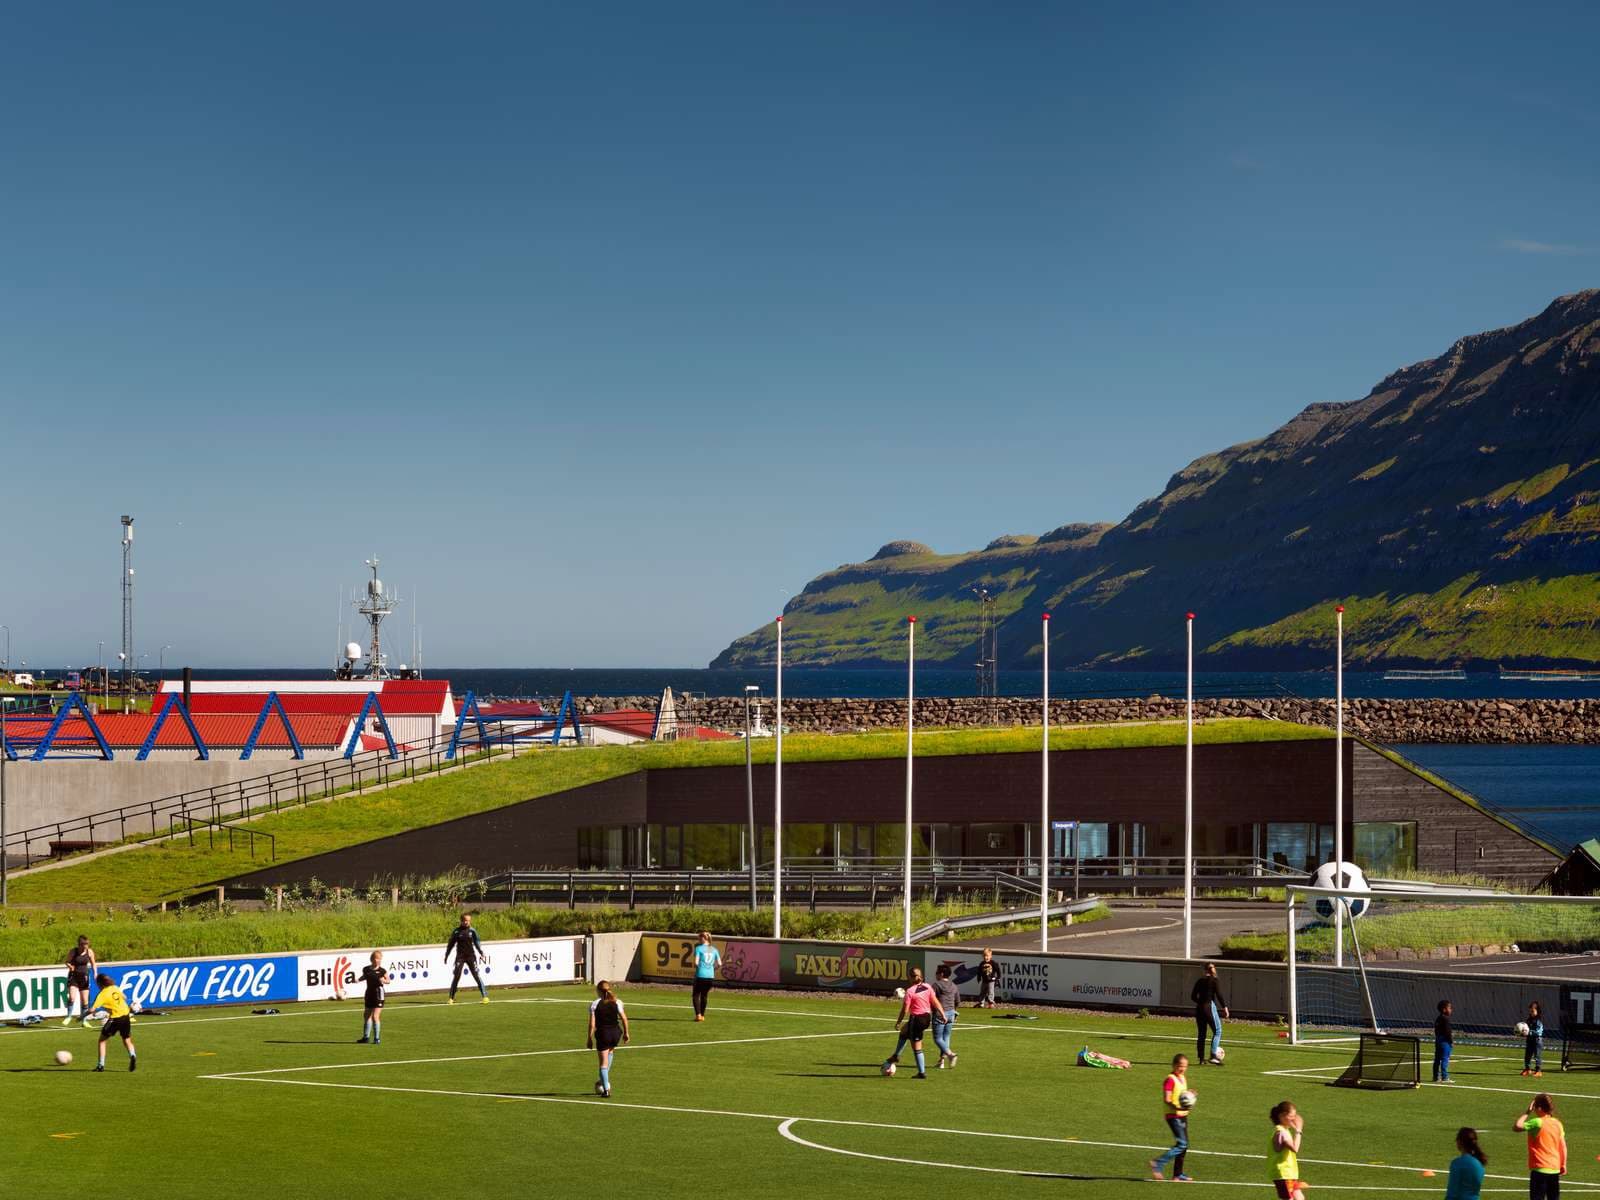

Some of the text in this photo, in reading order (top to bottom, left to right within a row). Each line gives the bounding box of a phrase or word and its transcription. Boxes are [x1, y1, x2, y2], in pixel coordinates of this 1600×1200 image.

[389, 959, 429, 971] ANSNI
[515, 952, 552, 963] ANSNI
[657, 941, 700, 968] 9-2
[795, 955, 909, 980] FAXE KONDI
[1000, 963, 1049, 977] TLANTIC
[203, 963, 275, 1000] FLOG
[0, 977, 69, 1012] OHR
